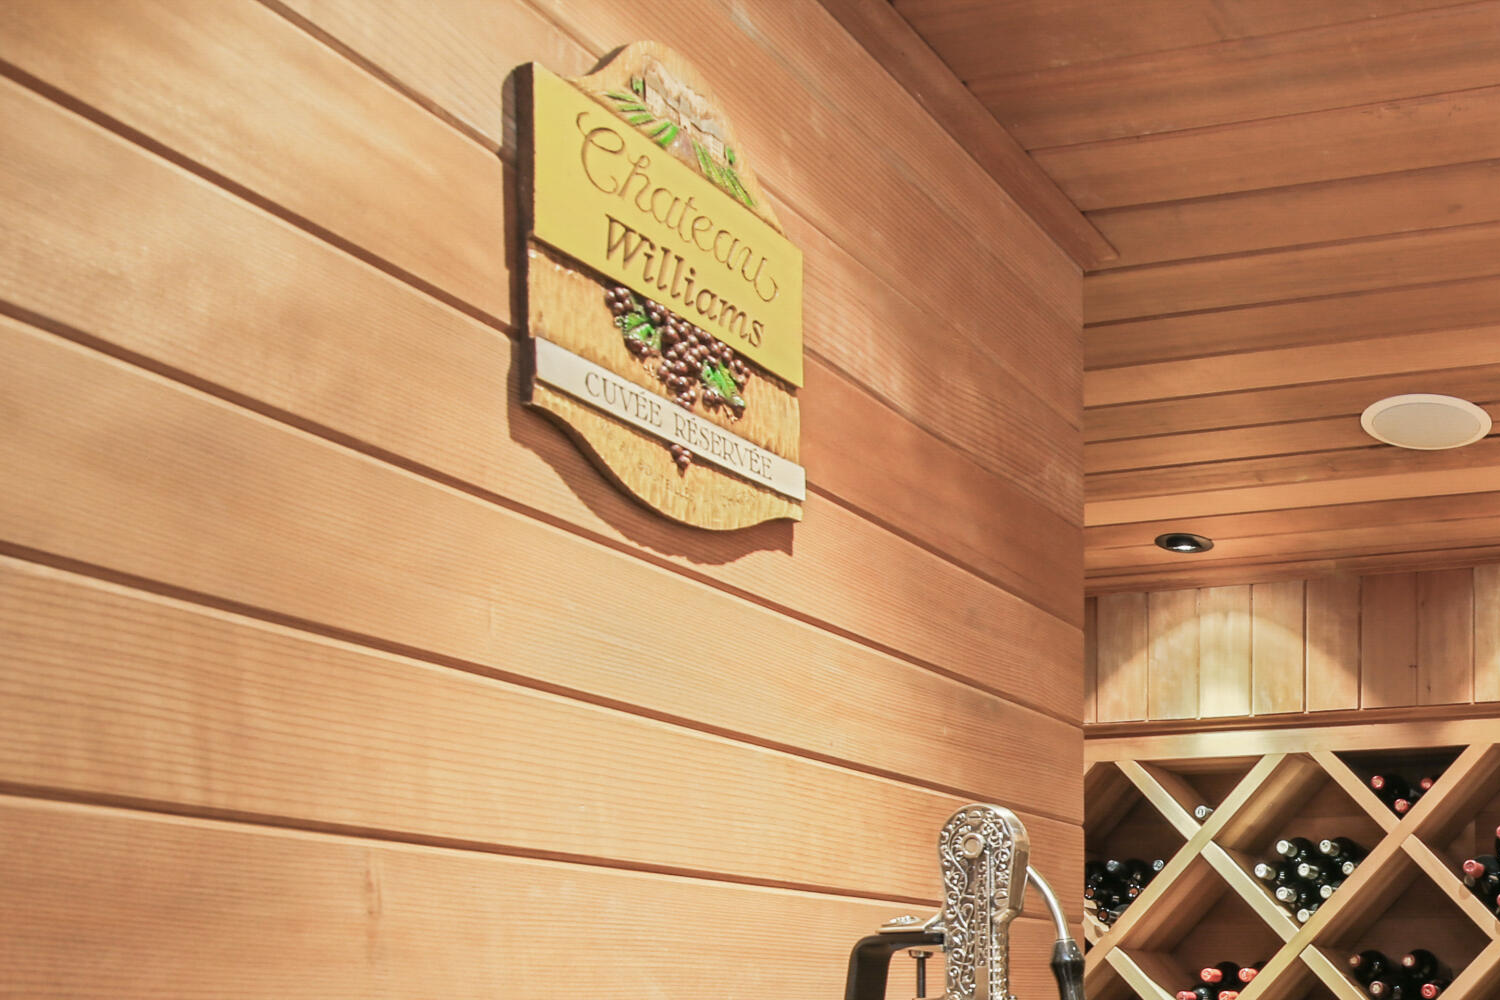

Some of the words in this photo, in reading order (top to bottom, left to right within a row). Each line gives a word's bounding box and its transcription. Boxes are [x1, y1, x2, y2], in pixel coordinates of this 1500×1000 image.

[576, 111, 778, 302] Chateau
[605, 213, 765, 348] Williams
[585, 371, 664, 429] CUVÉE
[673, 412, 773, 481] RÉSERVÉE
